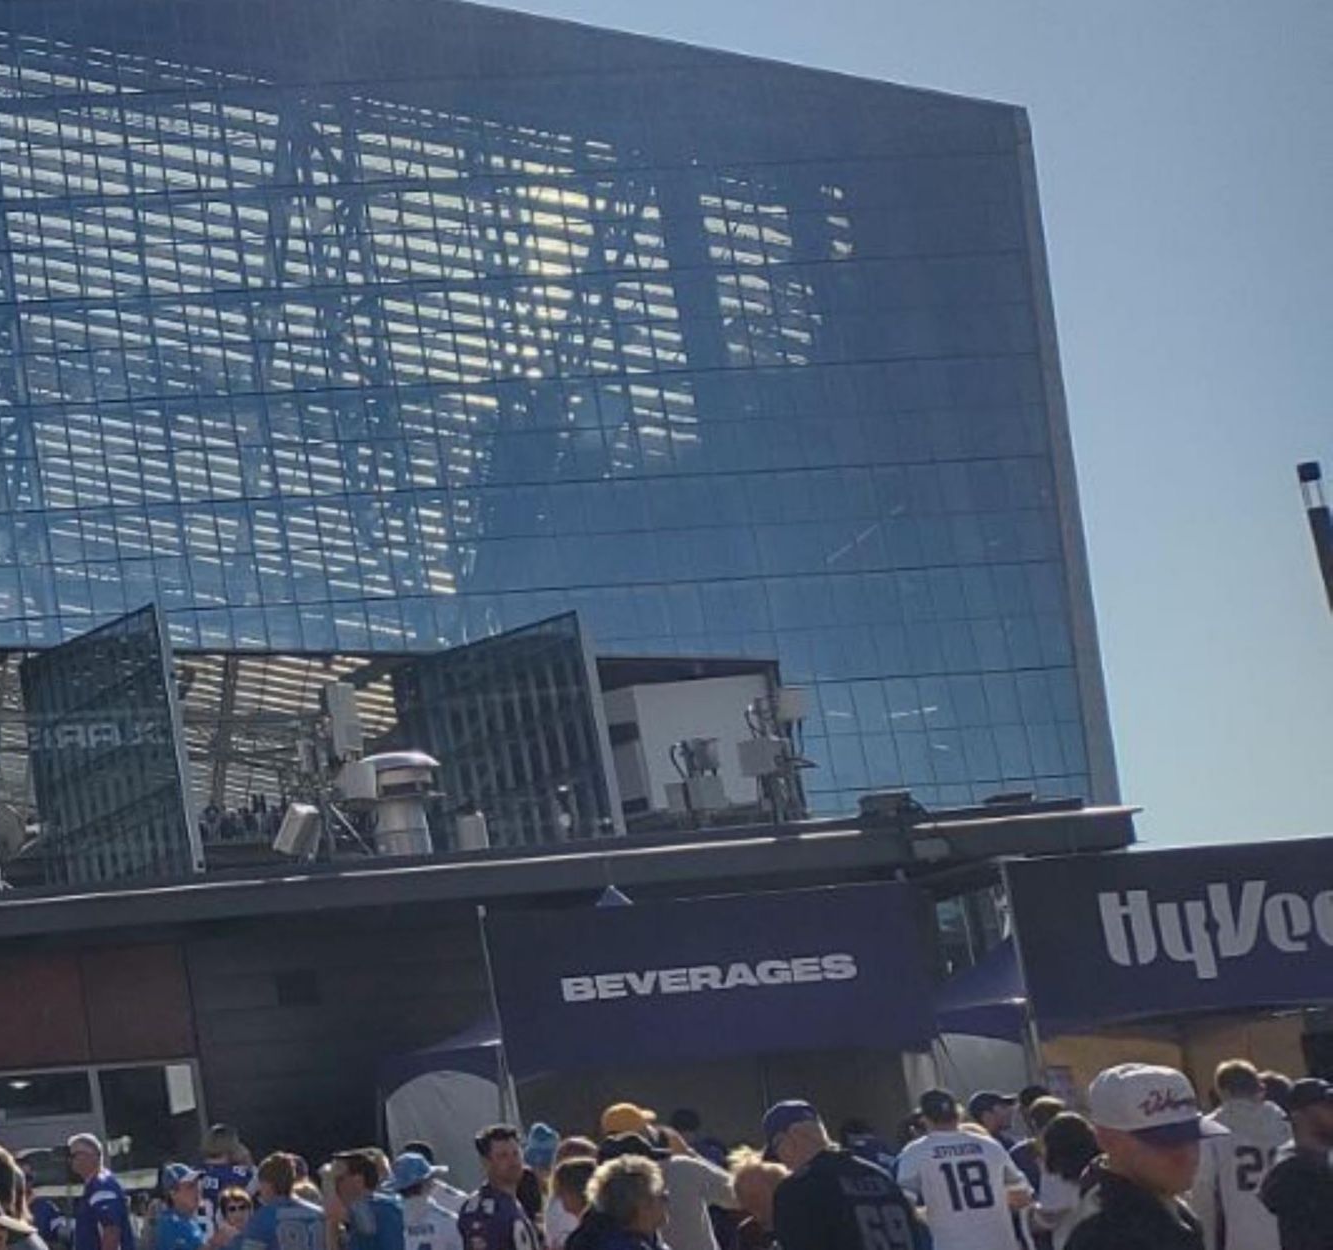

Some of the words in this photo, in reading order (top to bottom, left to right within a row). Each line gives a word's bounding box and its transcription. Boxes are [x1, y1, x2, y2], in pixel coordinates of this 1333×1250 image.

[561, 953, 858, 1002] BEVERAGES
[939, 1160, 995, 1211] 18
[1235, 1145, 1278, 1192] 2
